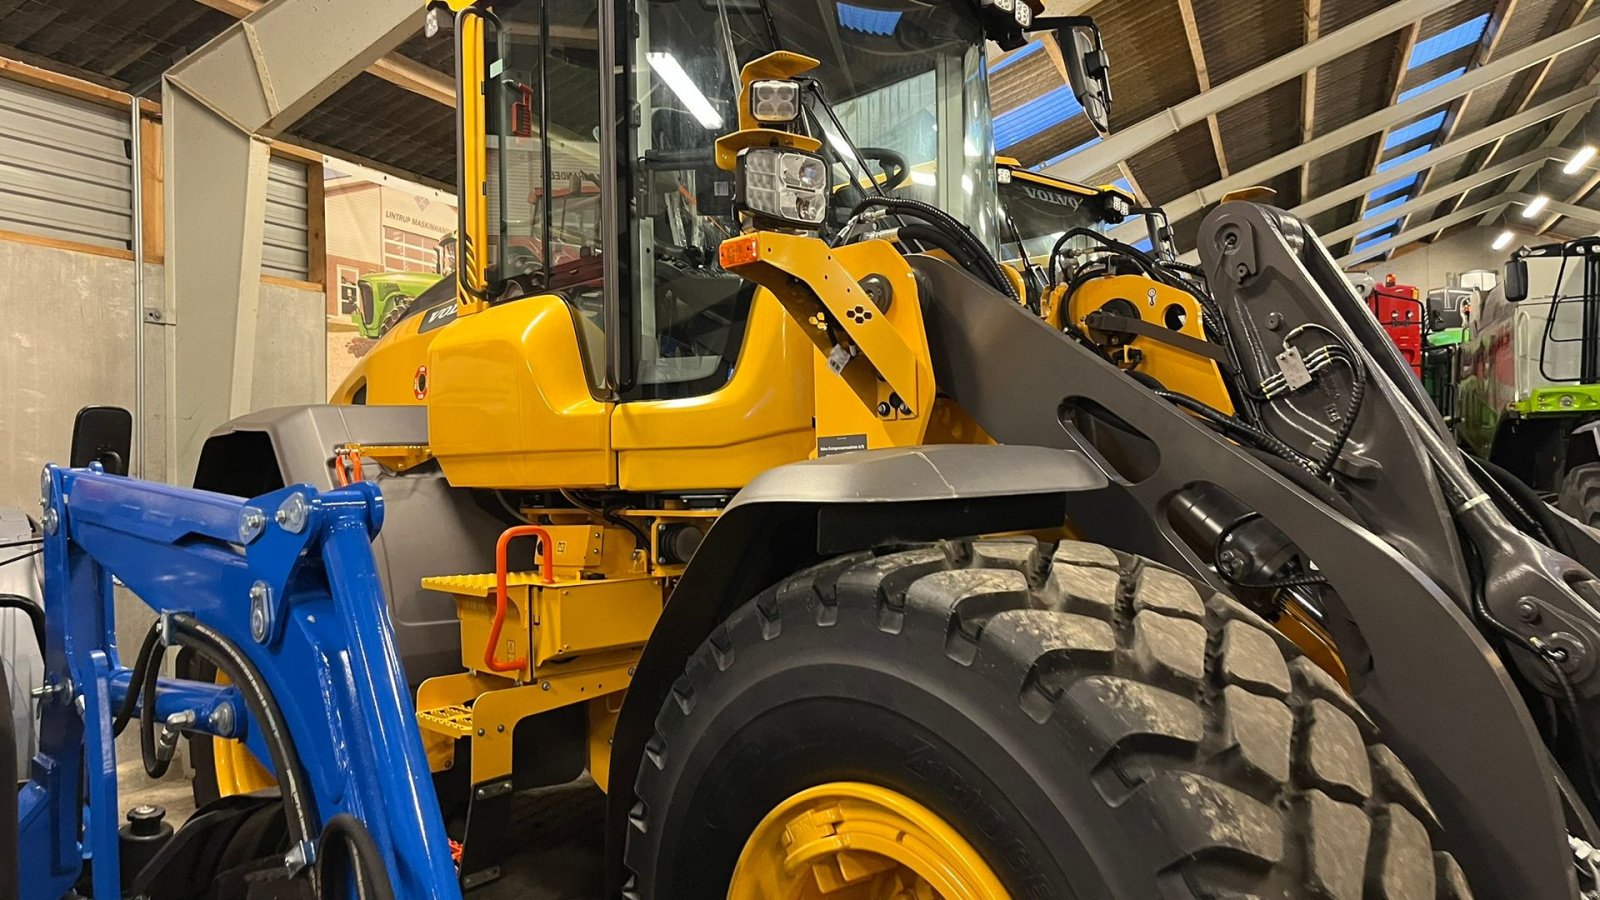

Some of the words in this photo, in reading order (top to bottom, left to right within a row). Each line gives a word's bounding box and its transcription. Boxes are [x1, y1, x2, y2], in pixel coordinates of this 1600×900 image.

[1023, 186, 1080, 209] VOLVO
[385, 210, 411, 224] LINTRUP
[428, 303, 458, 323] VOL
